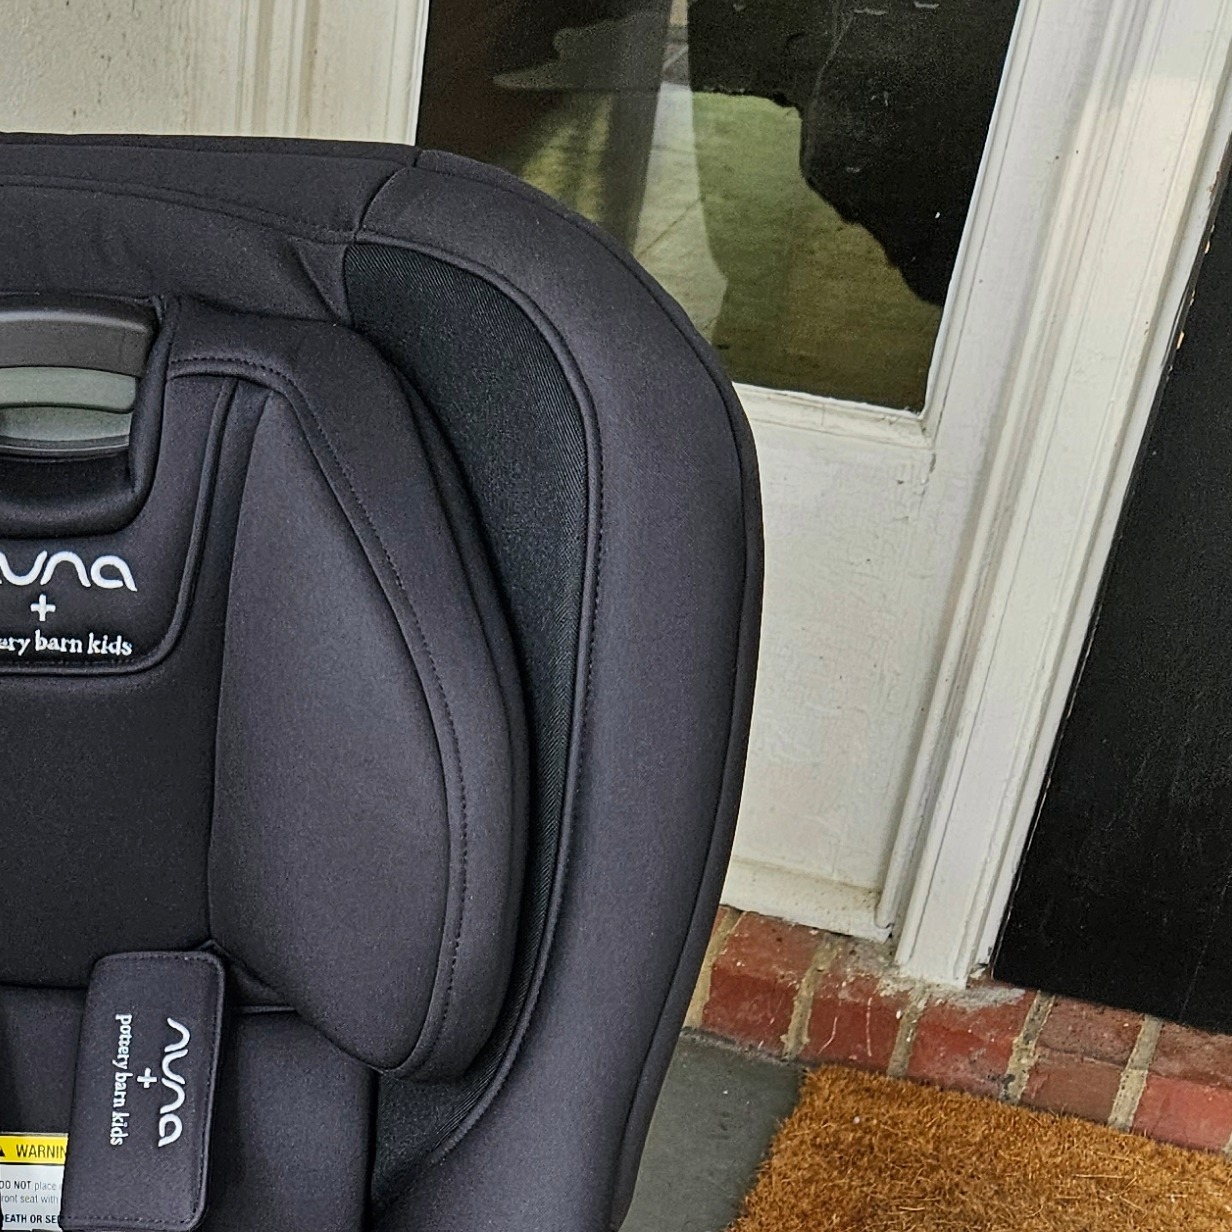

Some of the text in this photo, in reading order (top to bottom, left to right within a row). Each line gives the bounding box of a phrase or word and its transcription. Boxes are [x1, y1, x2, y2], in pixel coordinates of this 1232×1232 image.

[30, 593, 56, 622] +
[34, 628, 83, 654] barn
[87, 632, 133, 656] kids
[109, 1013, 133, 1146] pottery barn kids
[136, 1067, 157, 1089] +
[157, 1017, 191, 1147] nuna
[15, 1144, 67, 1158] WARNIN
[14, 1180, 32, 1190] NOT
[34, 1181, 57, 1192] place
[1, 1194, 59, 1204] ront seat with
[4, 1213, 60, 1224] EATH OR SE
